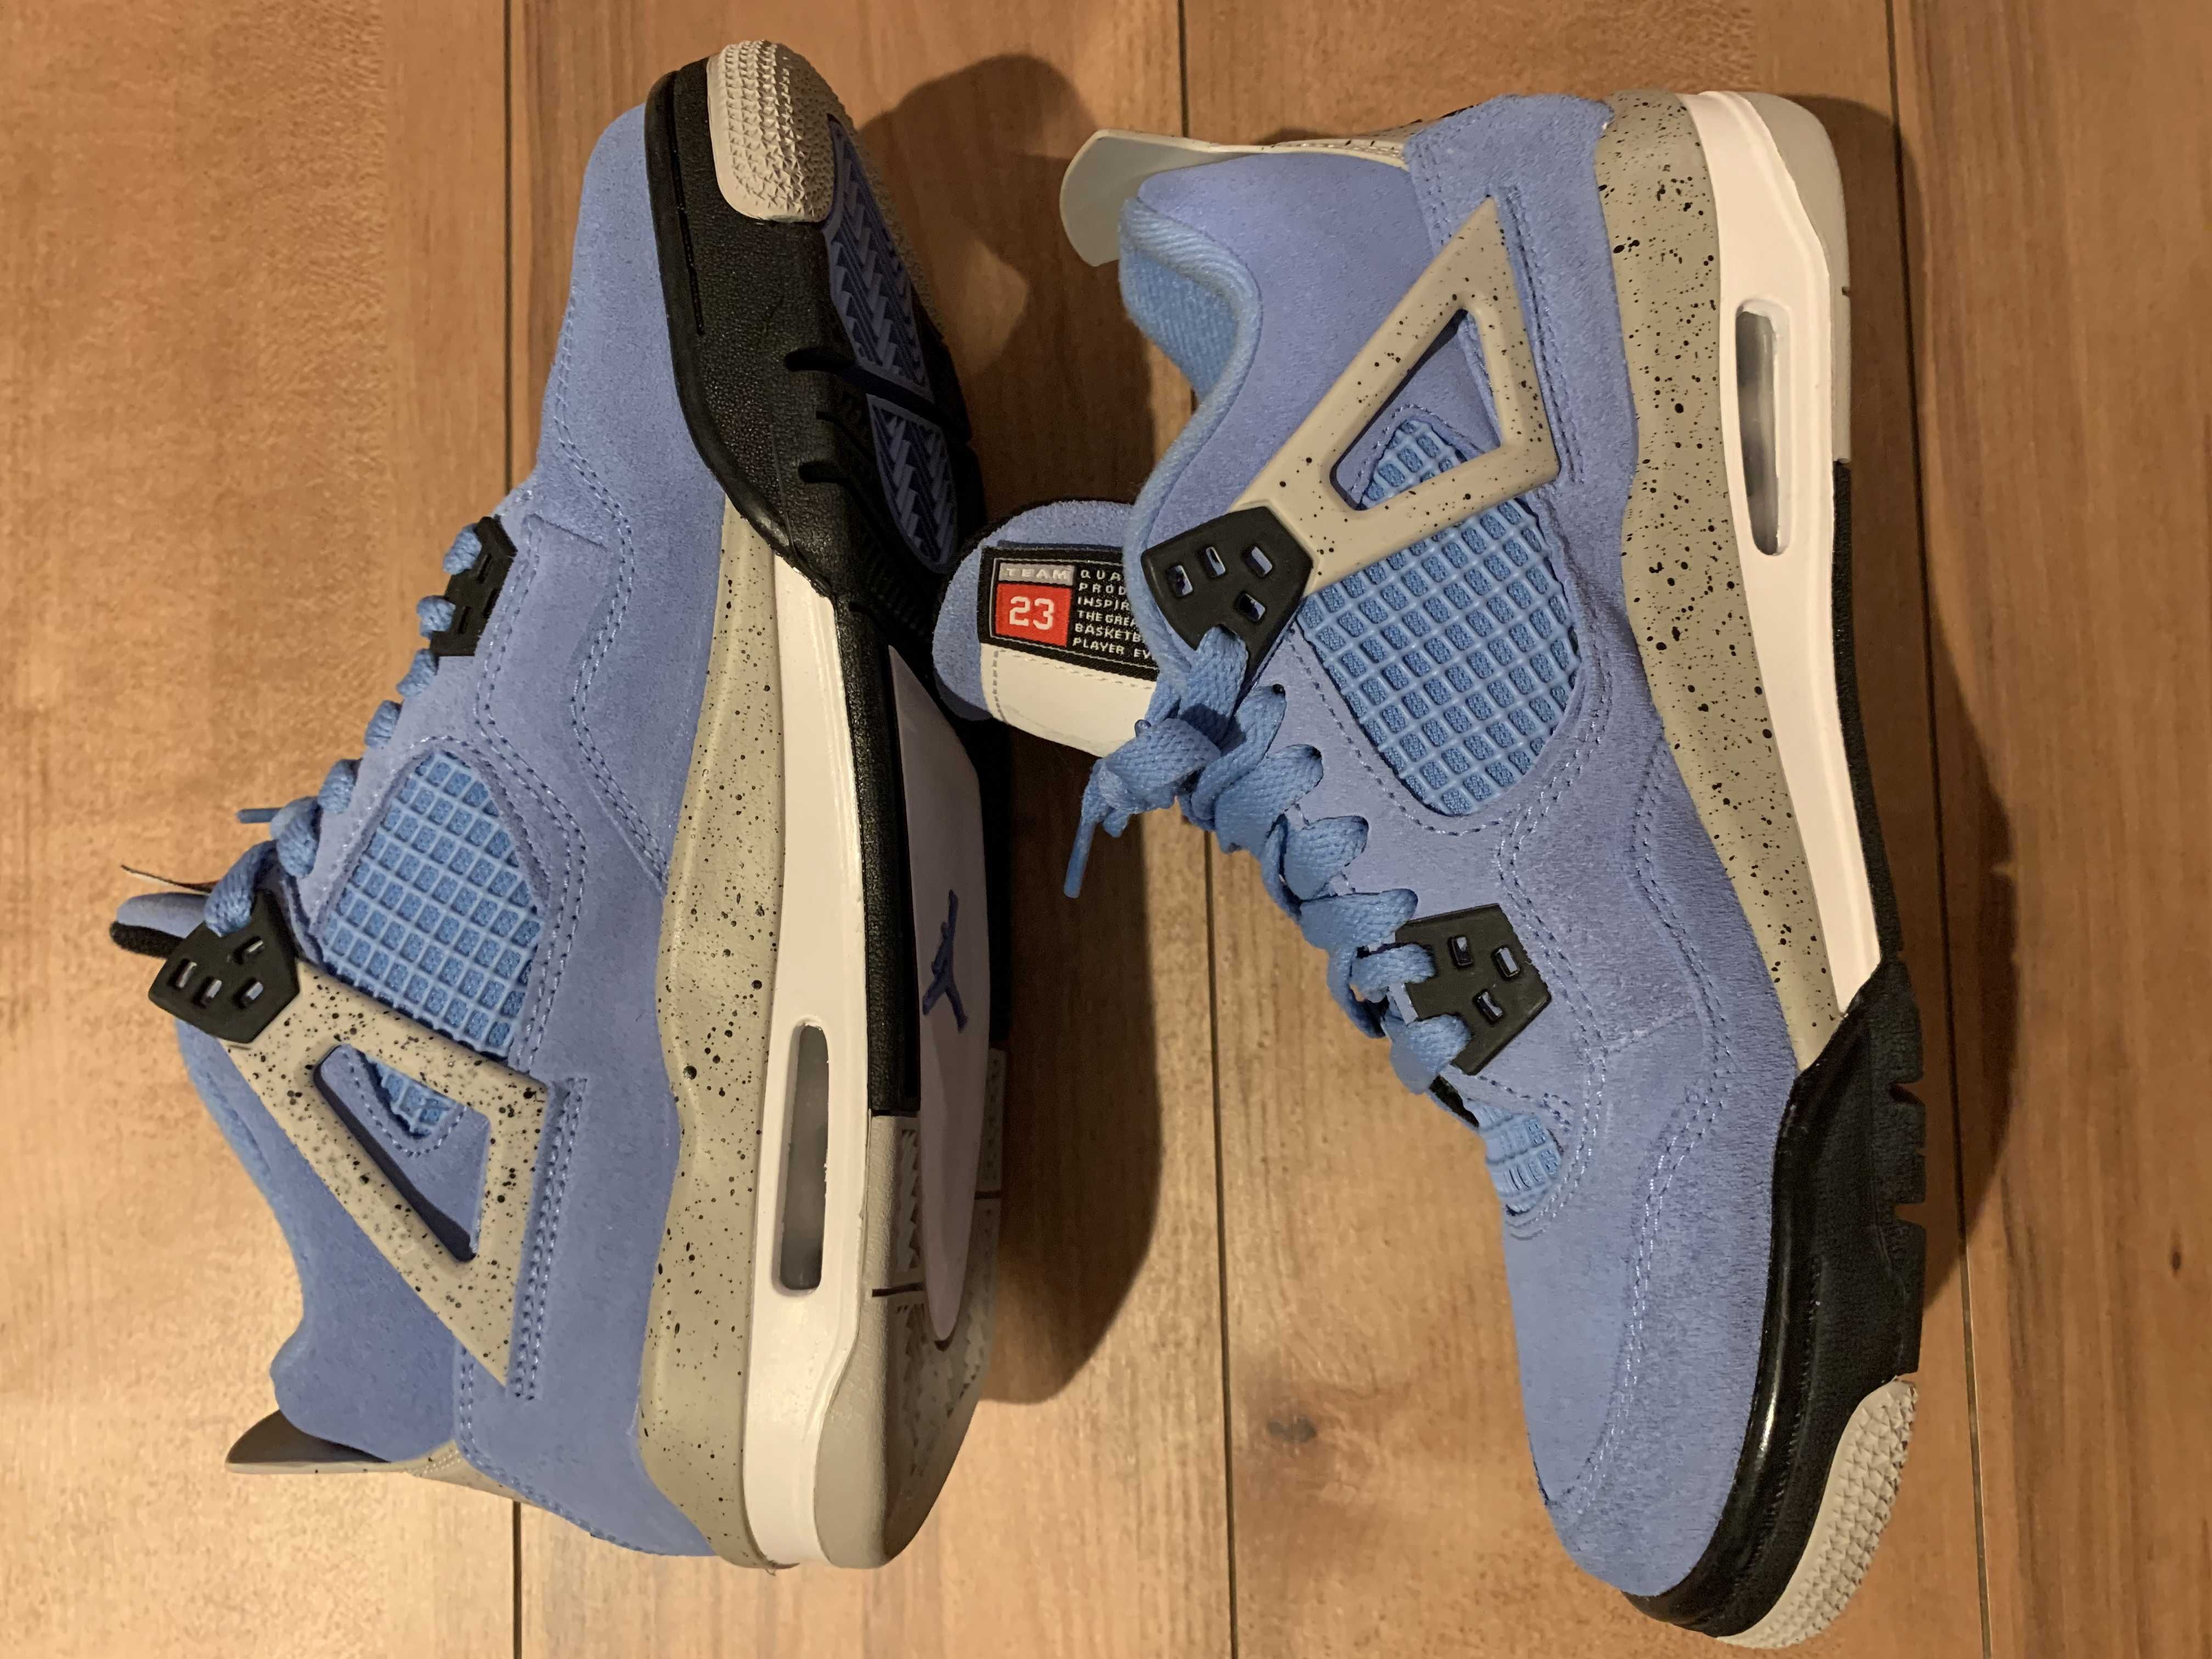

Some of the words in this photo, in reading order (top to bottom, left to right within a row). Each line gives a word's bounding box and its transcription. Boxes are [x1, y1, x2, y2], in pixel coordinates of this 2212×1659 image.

[1006, 567, 1068, 580] TEAM
[1080, 569, 1121, 581] QUA
[1079, 582, 1127, 596] PROD
[1077, 596, 1130, 611] INSPIR
[1009, 596, 1054, 630] 23
[1077, 610, 1103, 622] THE
[1105, 613, 1137, 627] GREA
[1075, 622, 1145, 643] BASKETB
[1072, 637, 1125, 655] PLAYER
[1133, 647, 1150, 659] EV
